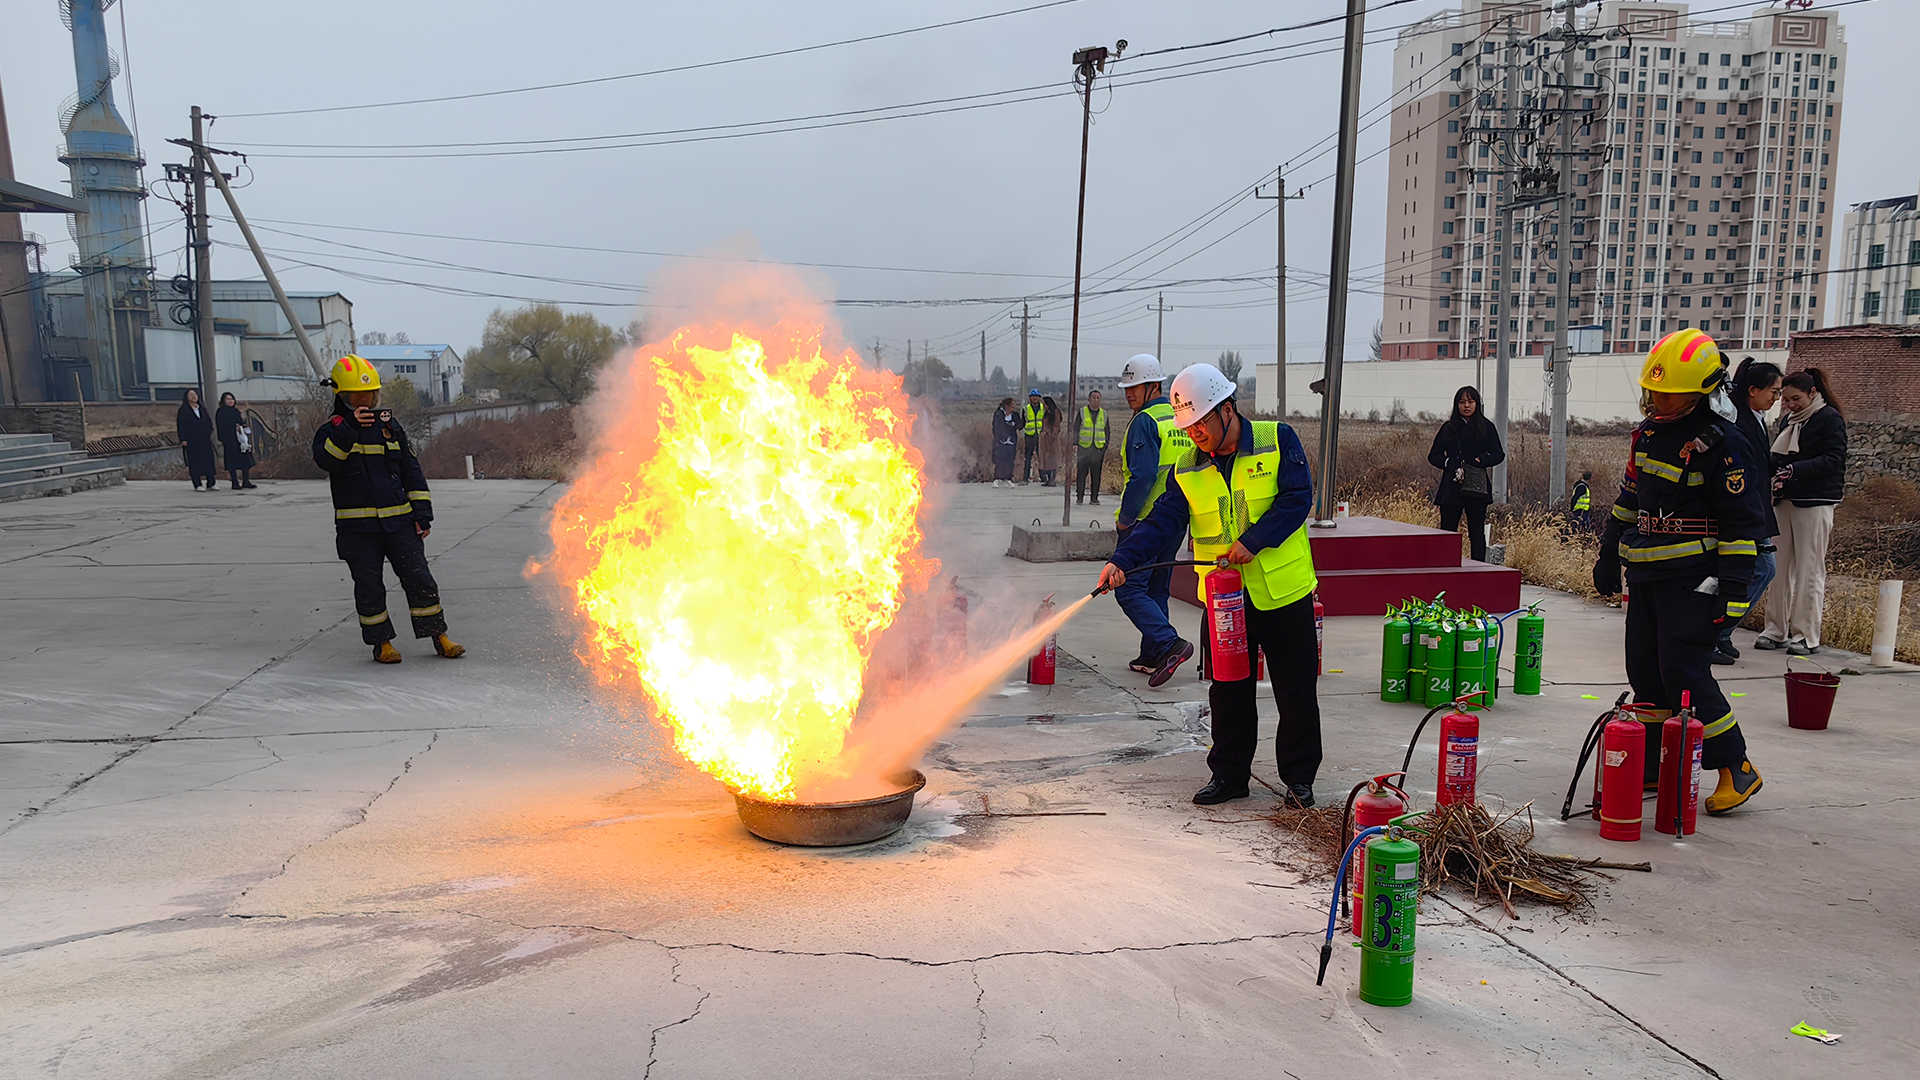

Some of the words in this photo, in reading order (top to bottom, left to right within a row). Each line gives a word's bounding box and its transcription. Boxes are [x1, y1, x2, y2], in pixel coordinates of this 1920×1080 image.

[1386, 679, 1406, 693] 23
[1430, 677, 1451, 692] 24
[1461, 681, 1481, 695] 24
[1373, 894, 1393, 948] 3
